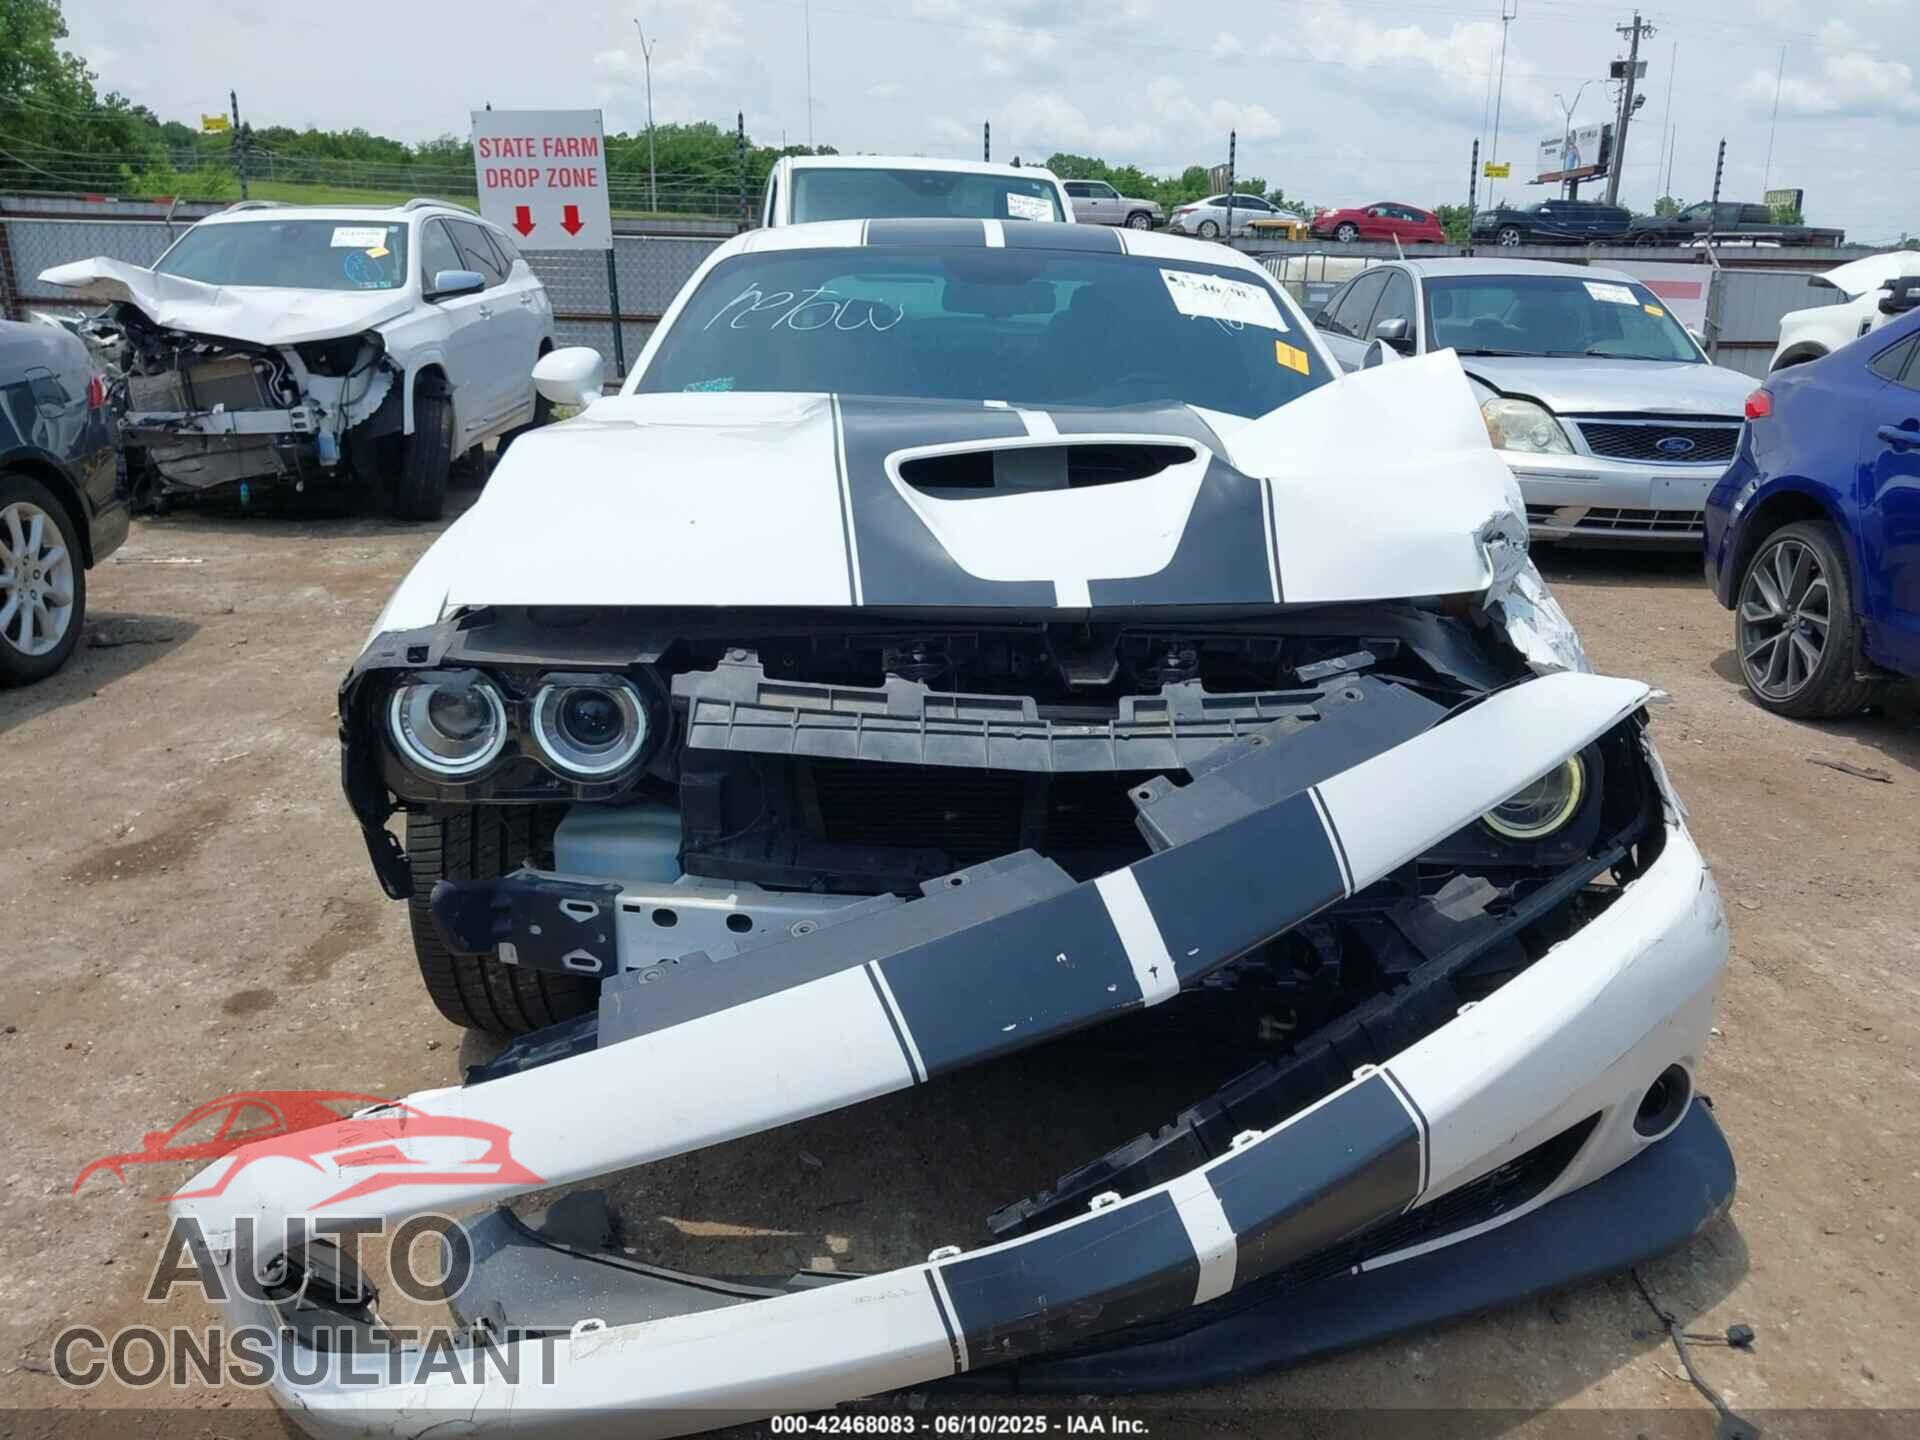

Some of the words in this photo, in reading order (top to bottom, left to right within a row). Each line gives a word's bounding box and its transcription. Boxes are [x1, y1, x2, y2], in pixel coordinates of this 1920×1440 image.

[479, 137, 537, 158] STATE
[543, 136, 599, 158] FARM
[486, 168, 540, 188] DROP
[546, 168, 599, 188] ZONE
